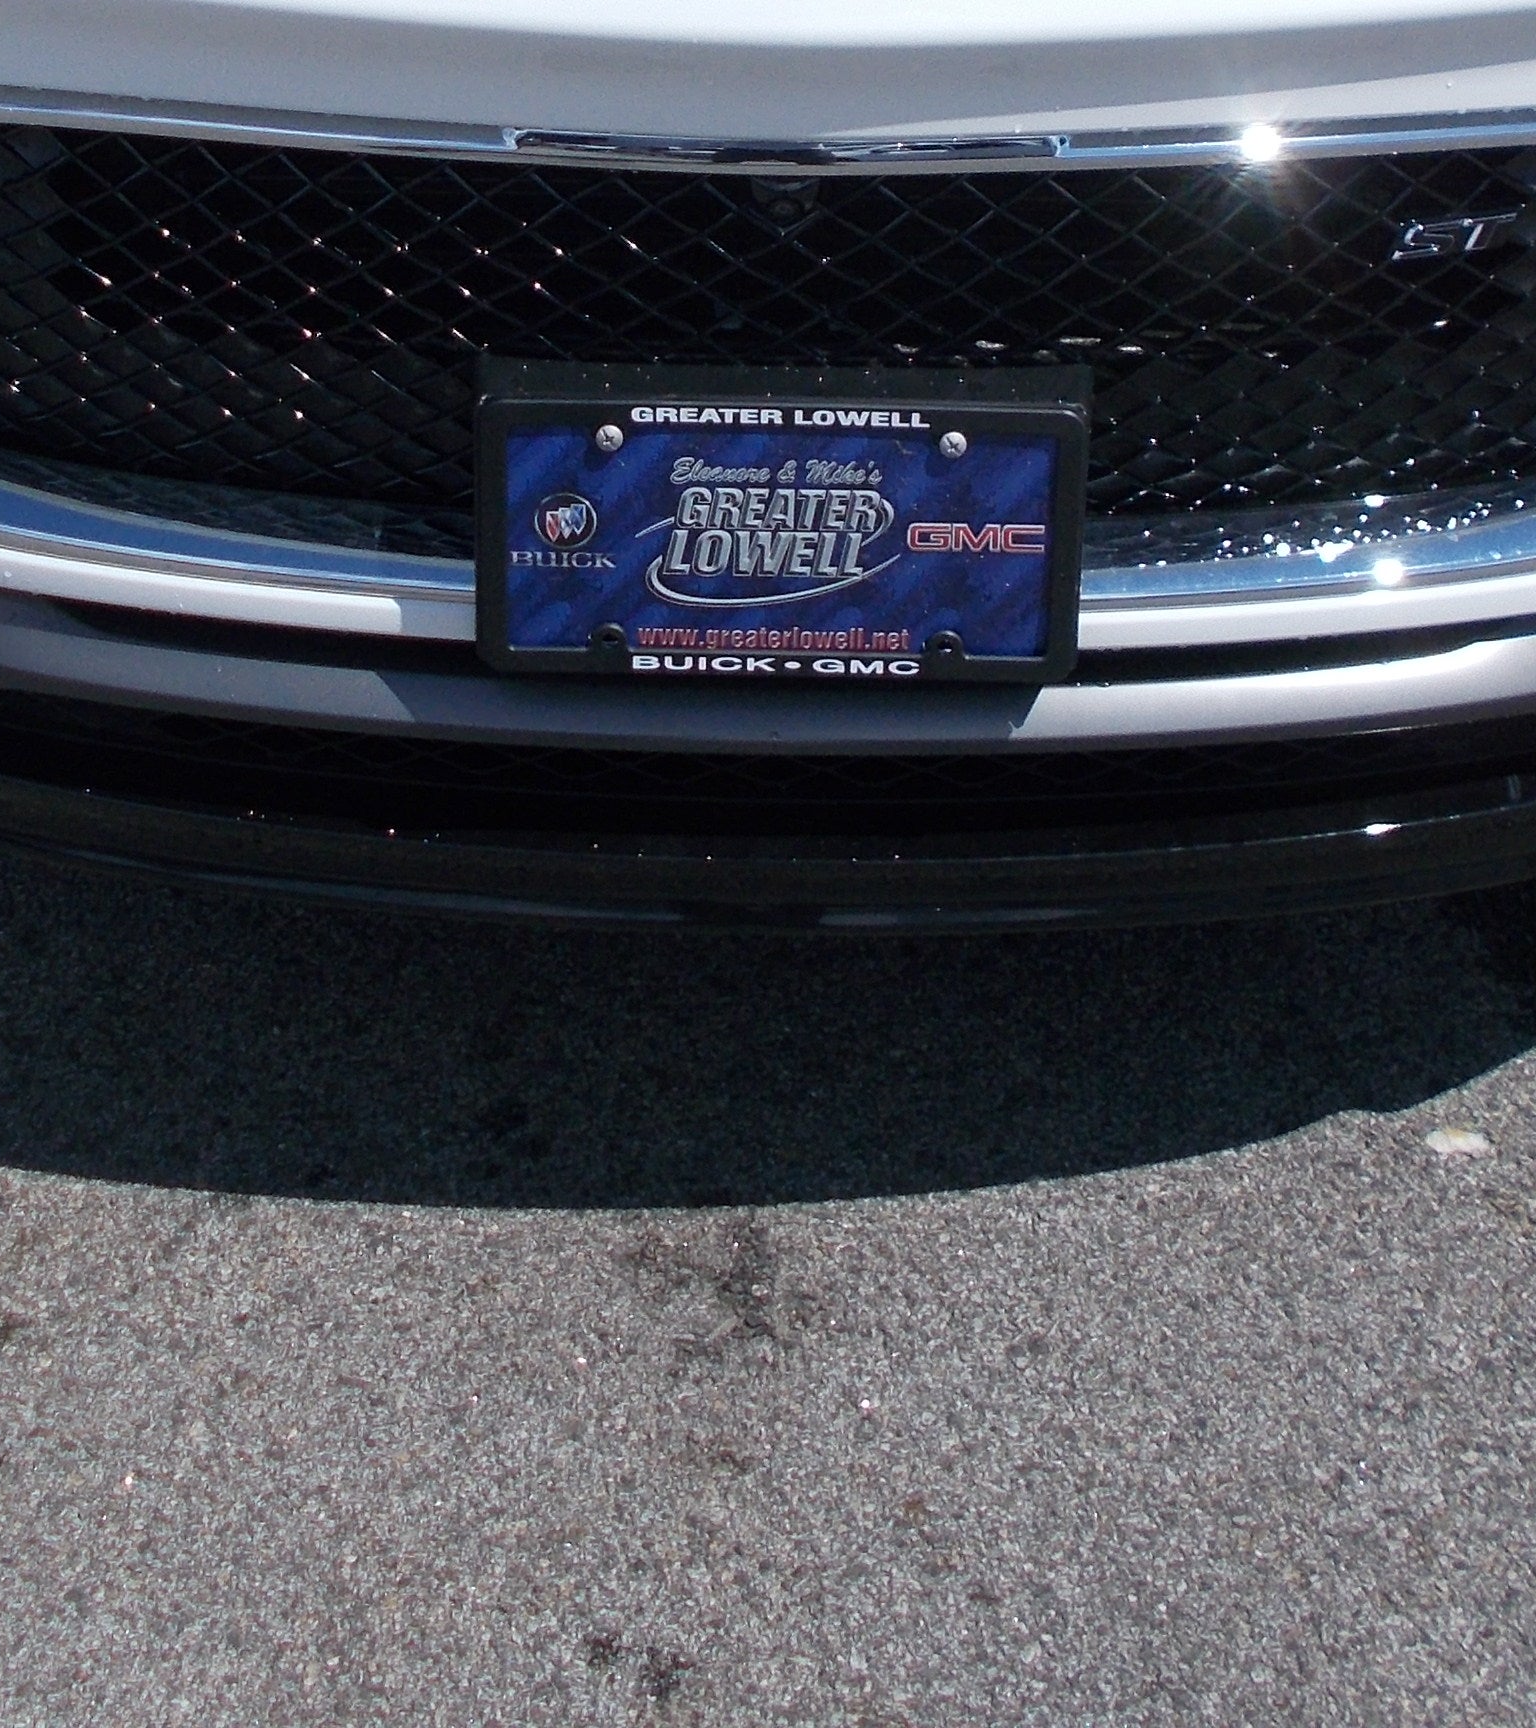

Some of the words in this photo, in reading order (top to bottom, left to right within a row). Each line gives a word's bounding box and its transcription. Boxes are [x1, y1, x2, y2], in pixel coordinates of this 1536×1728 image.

[1391, 212, 1518, 260] ST
[630, 406, 783, 425] GREATER
[794, 409, 931, 429] LOWELL
[669, 456, 772, 485] Eleanore
[776, 459, 798, 485] &
[804, 458, 883, 486] Mike's
[676, 486, 884, 532] GREATER
[906, 522, 1046, 554] GMC
[510, 549, 617, 570] BUICK
[663, 528, 866, 579] LOWELL
[636, 624, 911, 651] www.greaterlowell.net
[631, 655, 777, 672] BUICK
[811, 658, 921, 676] GMC
